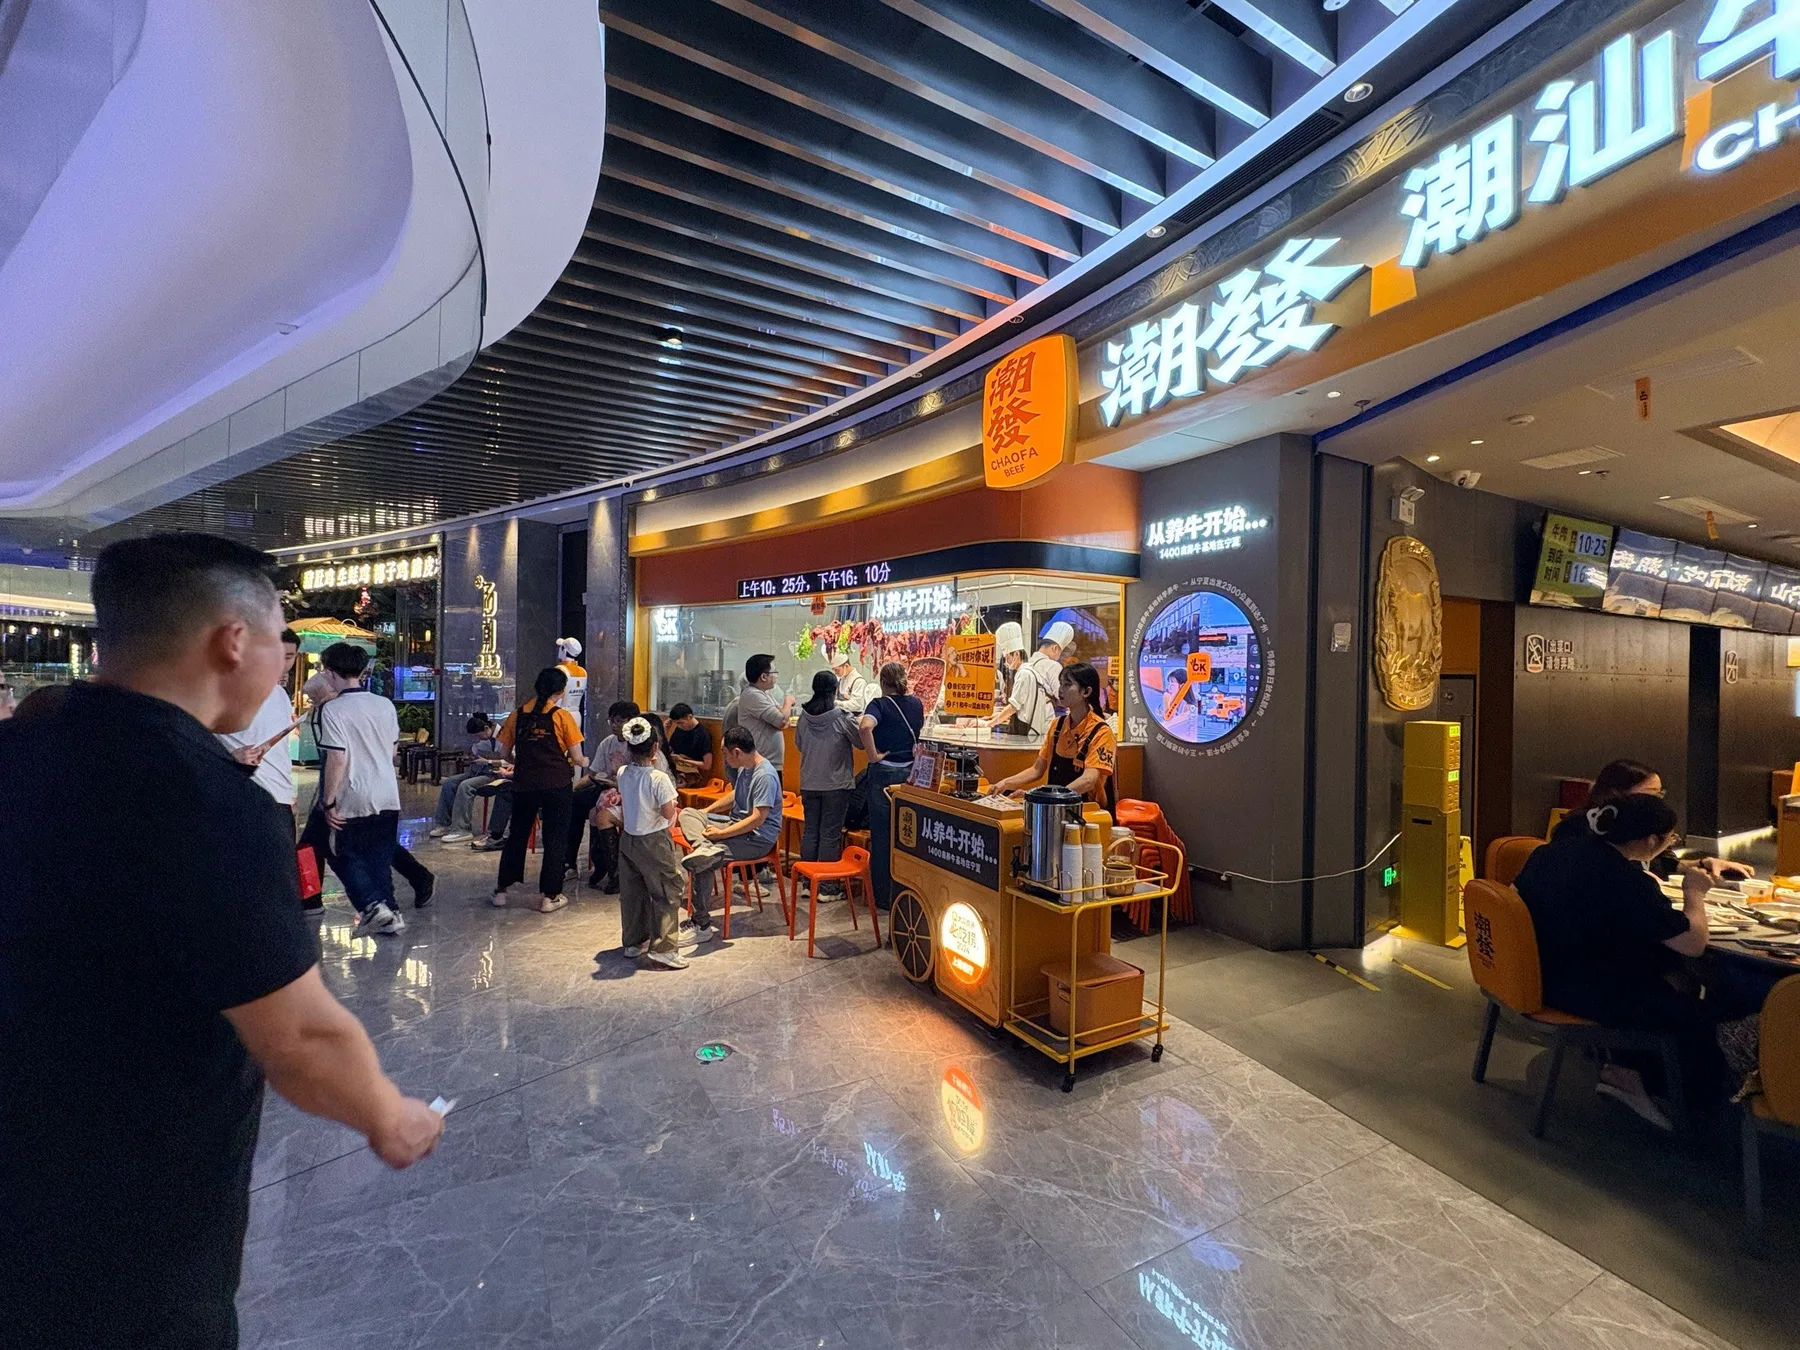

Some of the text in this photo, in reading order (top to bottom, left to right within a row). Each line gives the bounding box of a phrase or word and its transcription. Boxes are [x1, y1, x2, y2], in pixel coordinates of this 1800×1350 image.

[988, 350, 1041, 454] 潮發
[990, 447, 1038, 471] CHAOFA
[1004, 463, 1026, 477] BEEF
[1579, 534, 1607, 557] 10:25
